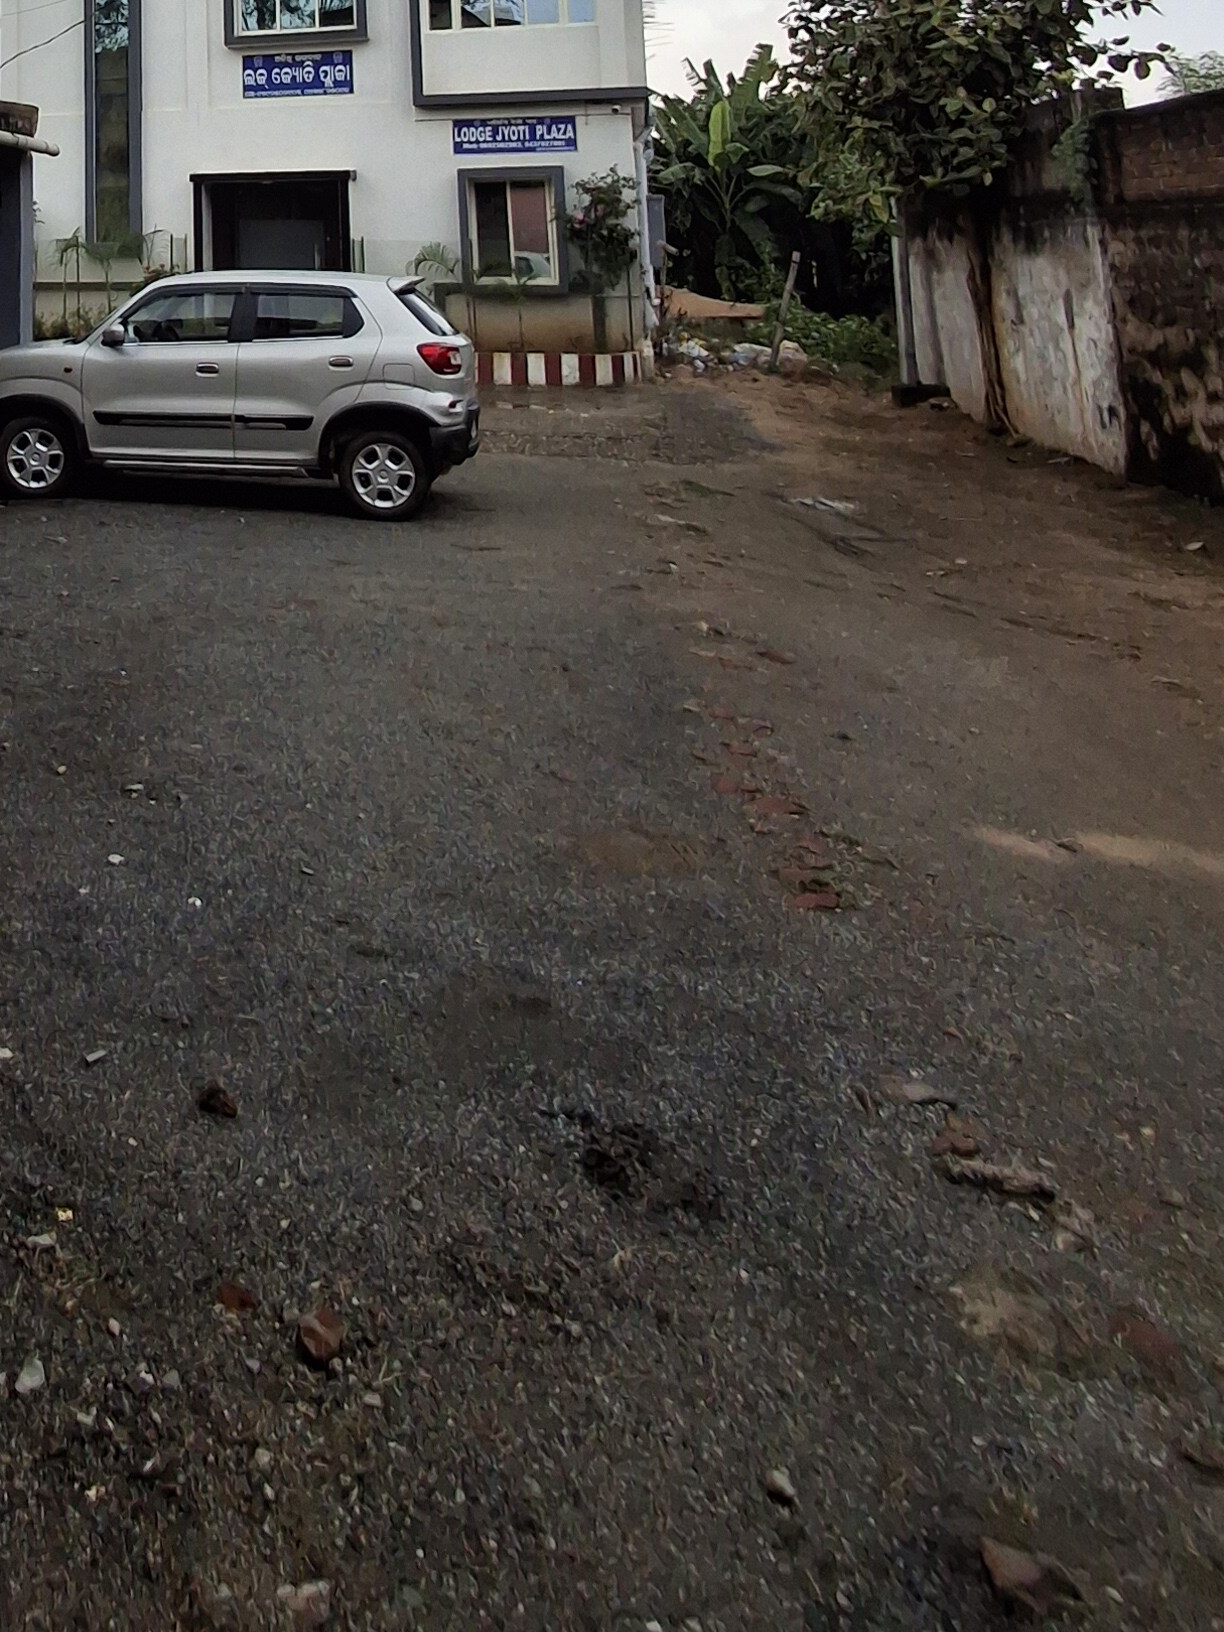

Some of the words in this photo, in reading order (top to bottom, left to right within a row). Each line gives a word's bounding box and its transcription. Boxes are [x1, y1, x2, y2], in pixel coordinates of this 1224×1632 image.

[454, 126, 493, 142] LODGE
[496, 125, 530, 141] JYOTI
[535, 123, 575, 140] PLAZA
